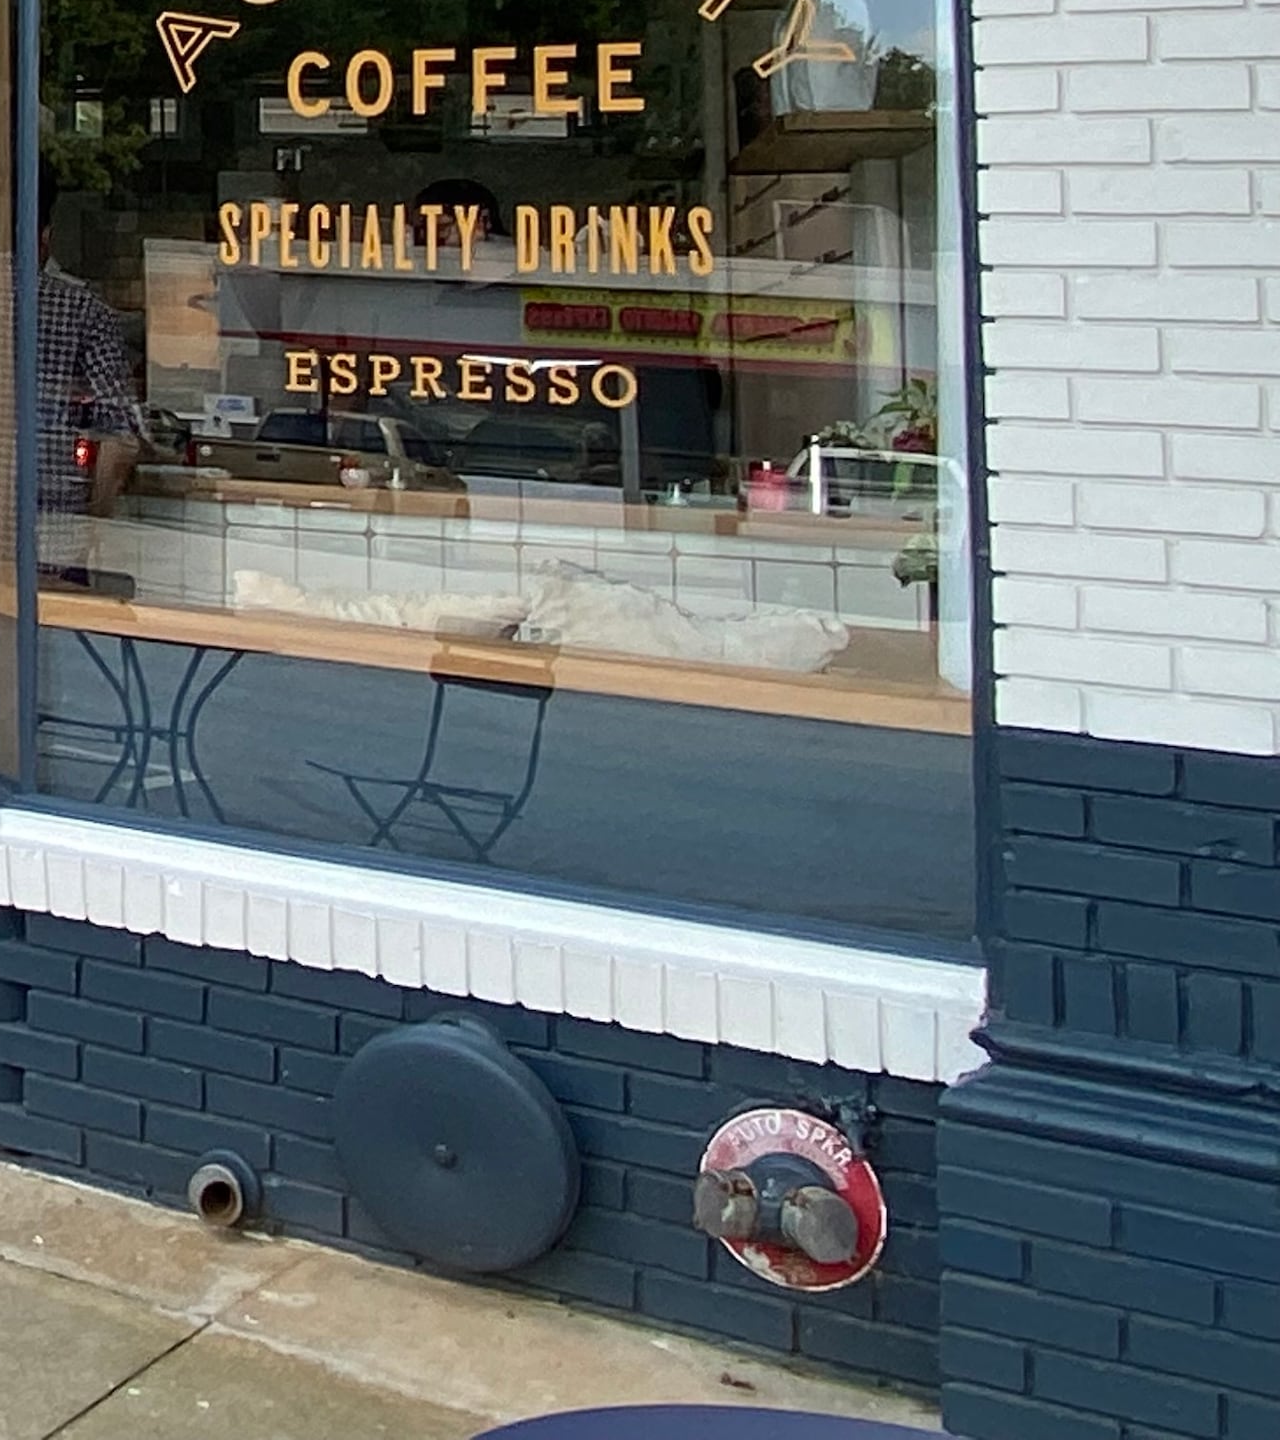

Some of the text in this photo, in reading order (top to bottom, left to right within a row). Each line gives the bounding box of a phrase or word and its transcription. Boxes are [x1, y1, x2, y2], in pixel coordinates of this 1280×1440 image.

[287, 42, 646, 118] COFFEE
[218, 201, 715, 277] SPECIALTY DRINKS
[284, 350, 638, 410] ESPRESSO
